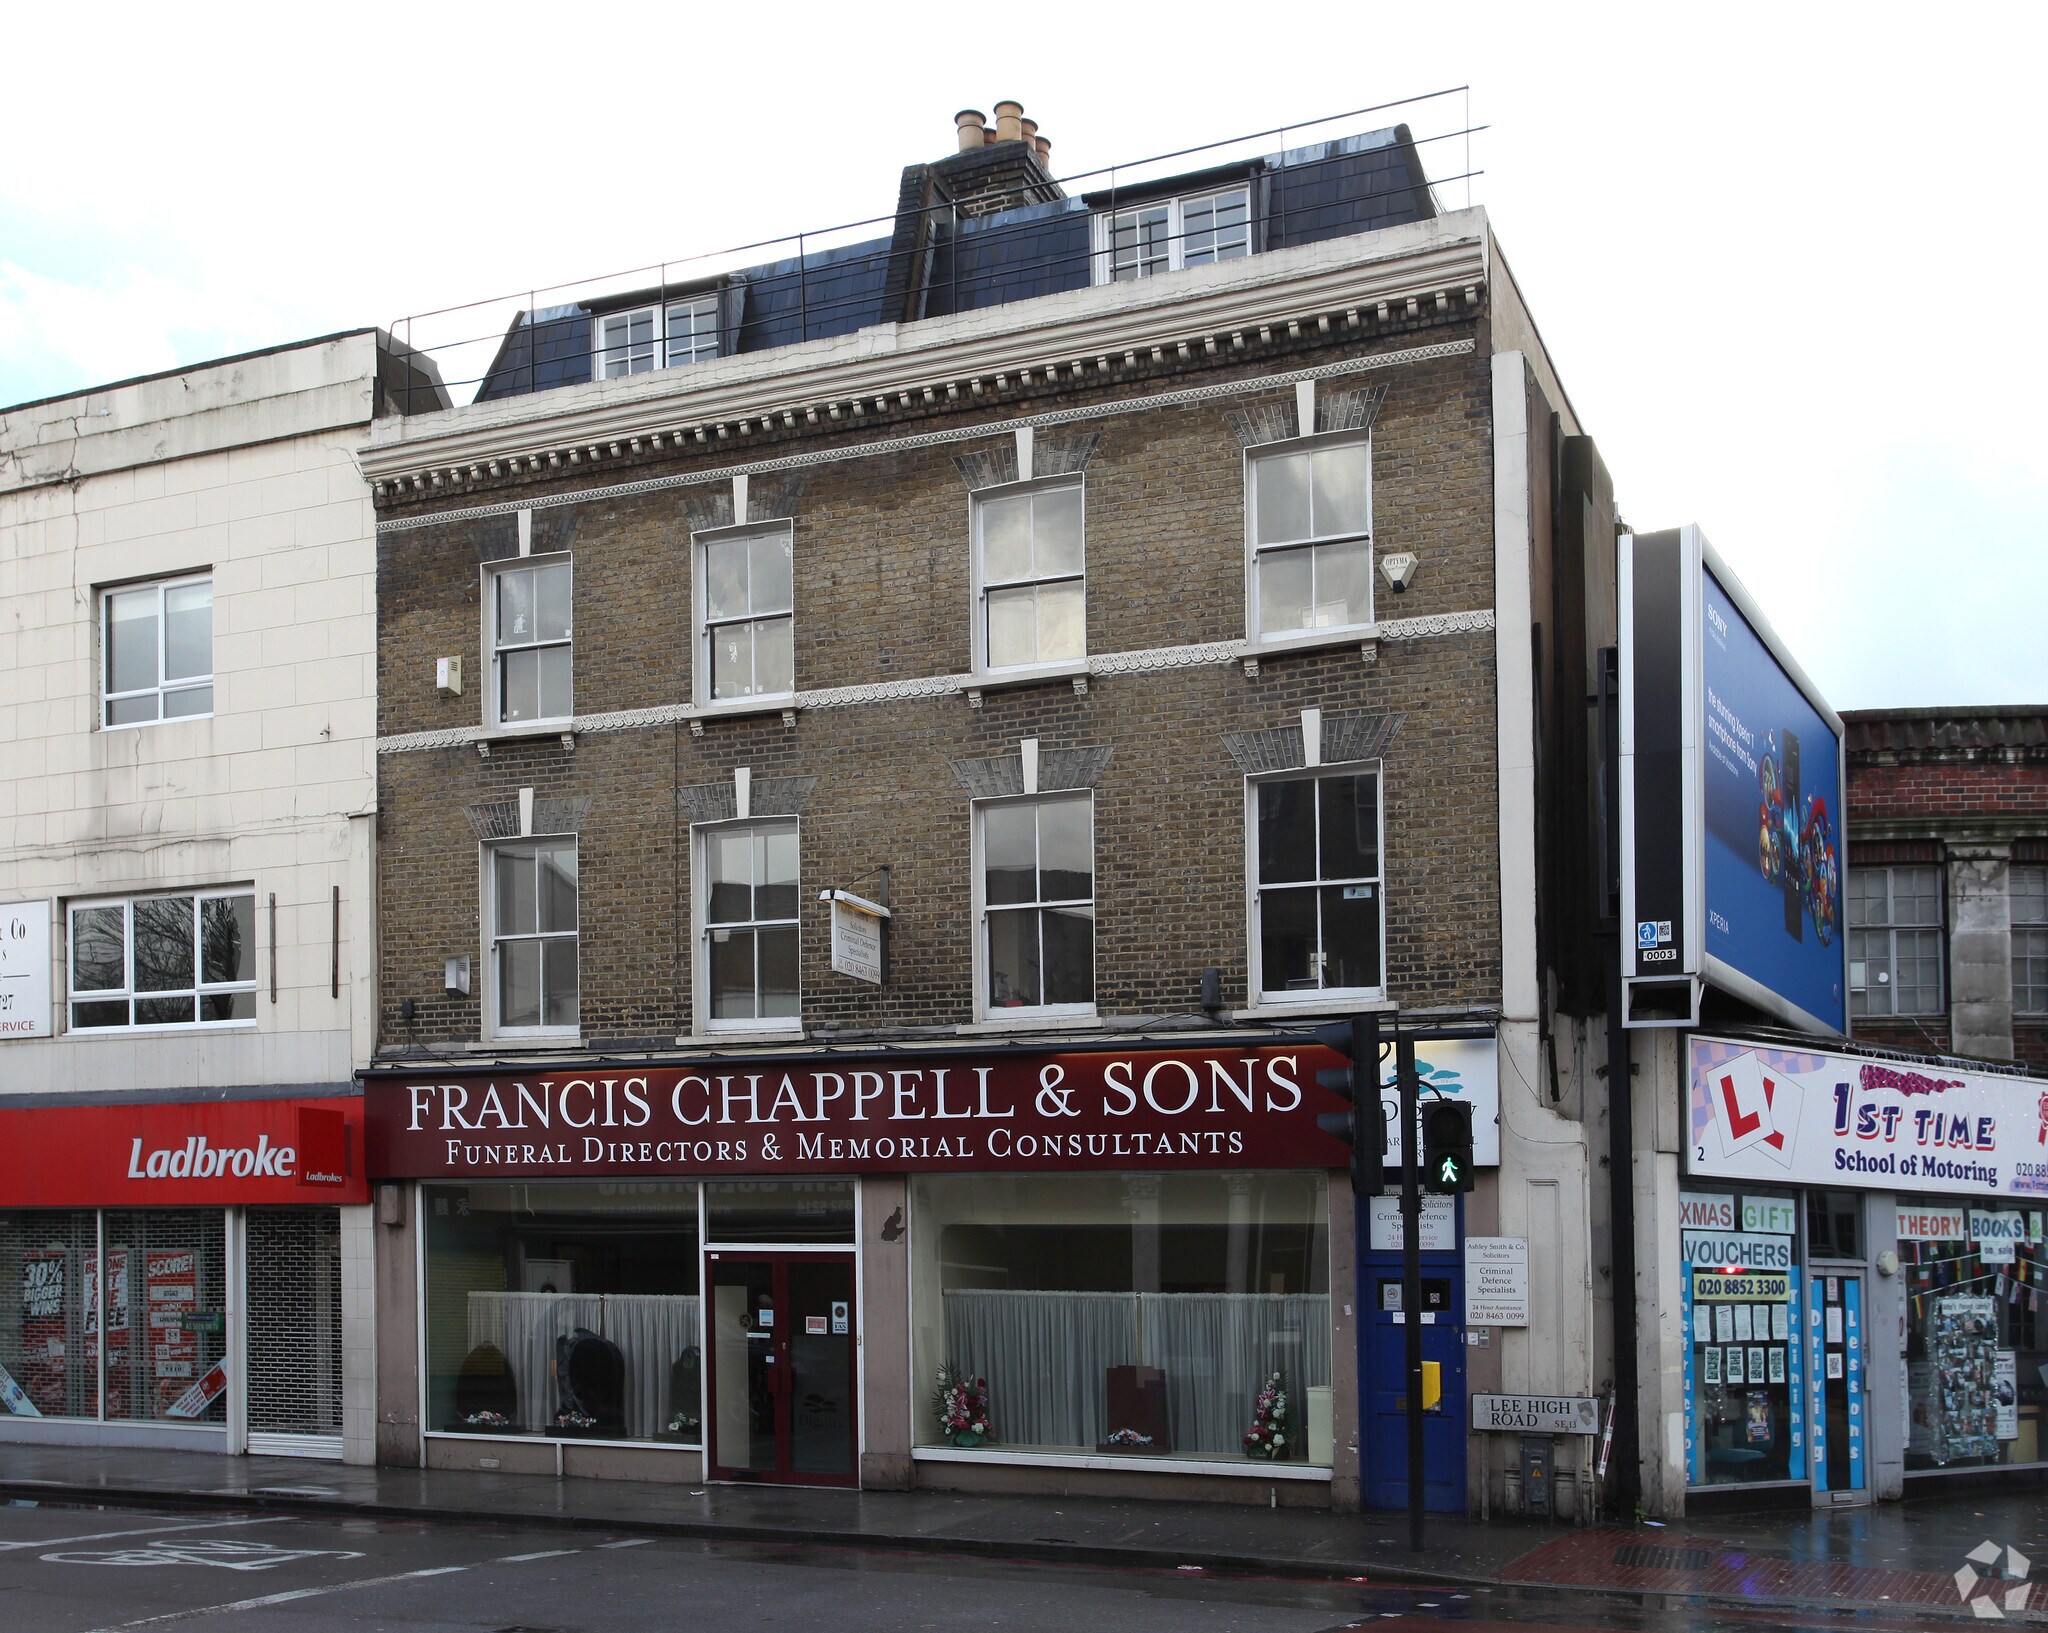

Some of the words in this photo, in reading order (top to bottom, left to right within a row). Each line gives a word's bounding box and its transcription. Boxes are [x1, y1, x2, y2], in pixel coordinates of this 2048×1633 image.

[1707, 603, 1728, 638] SONY
[1716, 698, 1736, 733] stunning
[1736, 717, 1751, 745] Xperia
[1708, 714, 1737, 753] smartphone
[1736, 741, 1747, 764] from
[1746, 751, 1758, 778] Sony
[11, 917, 26, 939] Co
[1709, 909, 1730, 935] XPERIA
[841, 932, 859, 945] Criminal
[859, 938, 877, 951] Defence
[847, 944, 870, 960] Specialists
[1646, 950, 1673, 960] 0003
[405, 1077, 652, 1131] FRANCIS
[671, 1067, 1015, 1126] CHAPPELL
[1034, 1064, 1081, 1118] &
[1103, 1055, 1302, 1116] SONS
[1833, 1082, 1903, 1143] 1ST
[1914, 1109, 1996, 1152] TIME
[128, 1134, 297, 1179] Ladbroke
[446, 1139, 572, 1165] FUNERAL
[582, 1136, 747, 1163] DIRECTORS
[760, 1133, 783, 1160] &
[796, 1132, 974, 1160] MEMORIAL
[987, 1128, 1243, 1157] CONSULTANTS
[1697, 1146, 1705, 1161] 2
[306, 1171, 343, 1182] Ladbrokes
[1834, 1148, 1896, 1175] School
[1899, 1154, 1919, 1176] of
[1922, 1160, 1998, 1188] Motoring
[2016, 1163, 2033, 1176] 020
[1420, 1200, 1453, 1209] Solicitors
[1680, 1201, 1732, 1227] XMAS
[1743, 1205, 1793, 1231] GIFT
[1898, 1214, 1961, 1236] THEORY
[1972, 1217, 2023, 1238] BOOKS
[2030, 1219, 2041, 1239] &
[1467, 1243, 1488, 1251] Ashley
[1685, 1240, 1789, 1267] VOUCHERS
[1997, 1245, 2013, 1255] sale
[23, 1259, 63, 1288] 30%
[147, 1254, 193, 1278] SCORE!
[1479, 1267, 1513, 1275] Criminal
[23, 1284, 63, 1302] BIGGER
[1477, 1286, 1516, 1295] Specialists
[1698, 1278, 1722, 1295] 020
[1724, 1278, 1754, 1295] 8852
[1756, 1279, 1786, 1295] 3300
[30, 1298, 62, 1316] WINS
[1486, 1312, 1504, 1320] 8463
[1789, 1288, 1802, 1448] Training
[1811, 1309, 1824, 1462] Driving
[1848, 1309, 1861, 1459] Lessons
[1490, 1399, 1522, 1412] LEE
[1527, 1400, 1570, 1414] HIGH
[1491, 1413, 1538, 1427] ROAD
